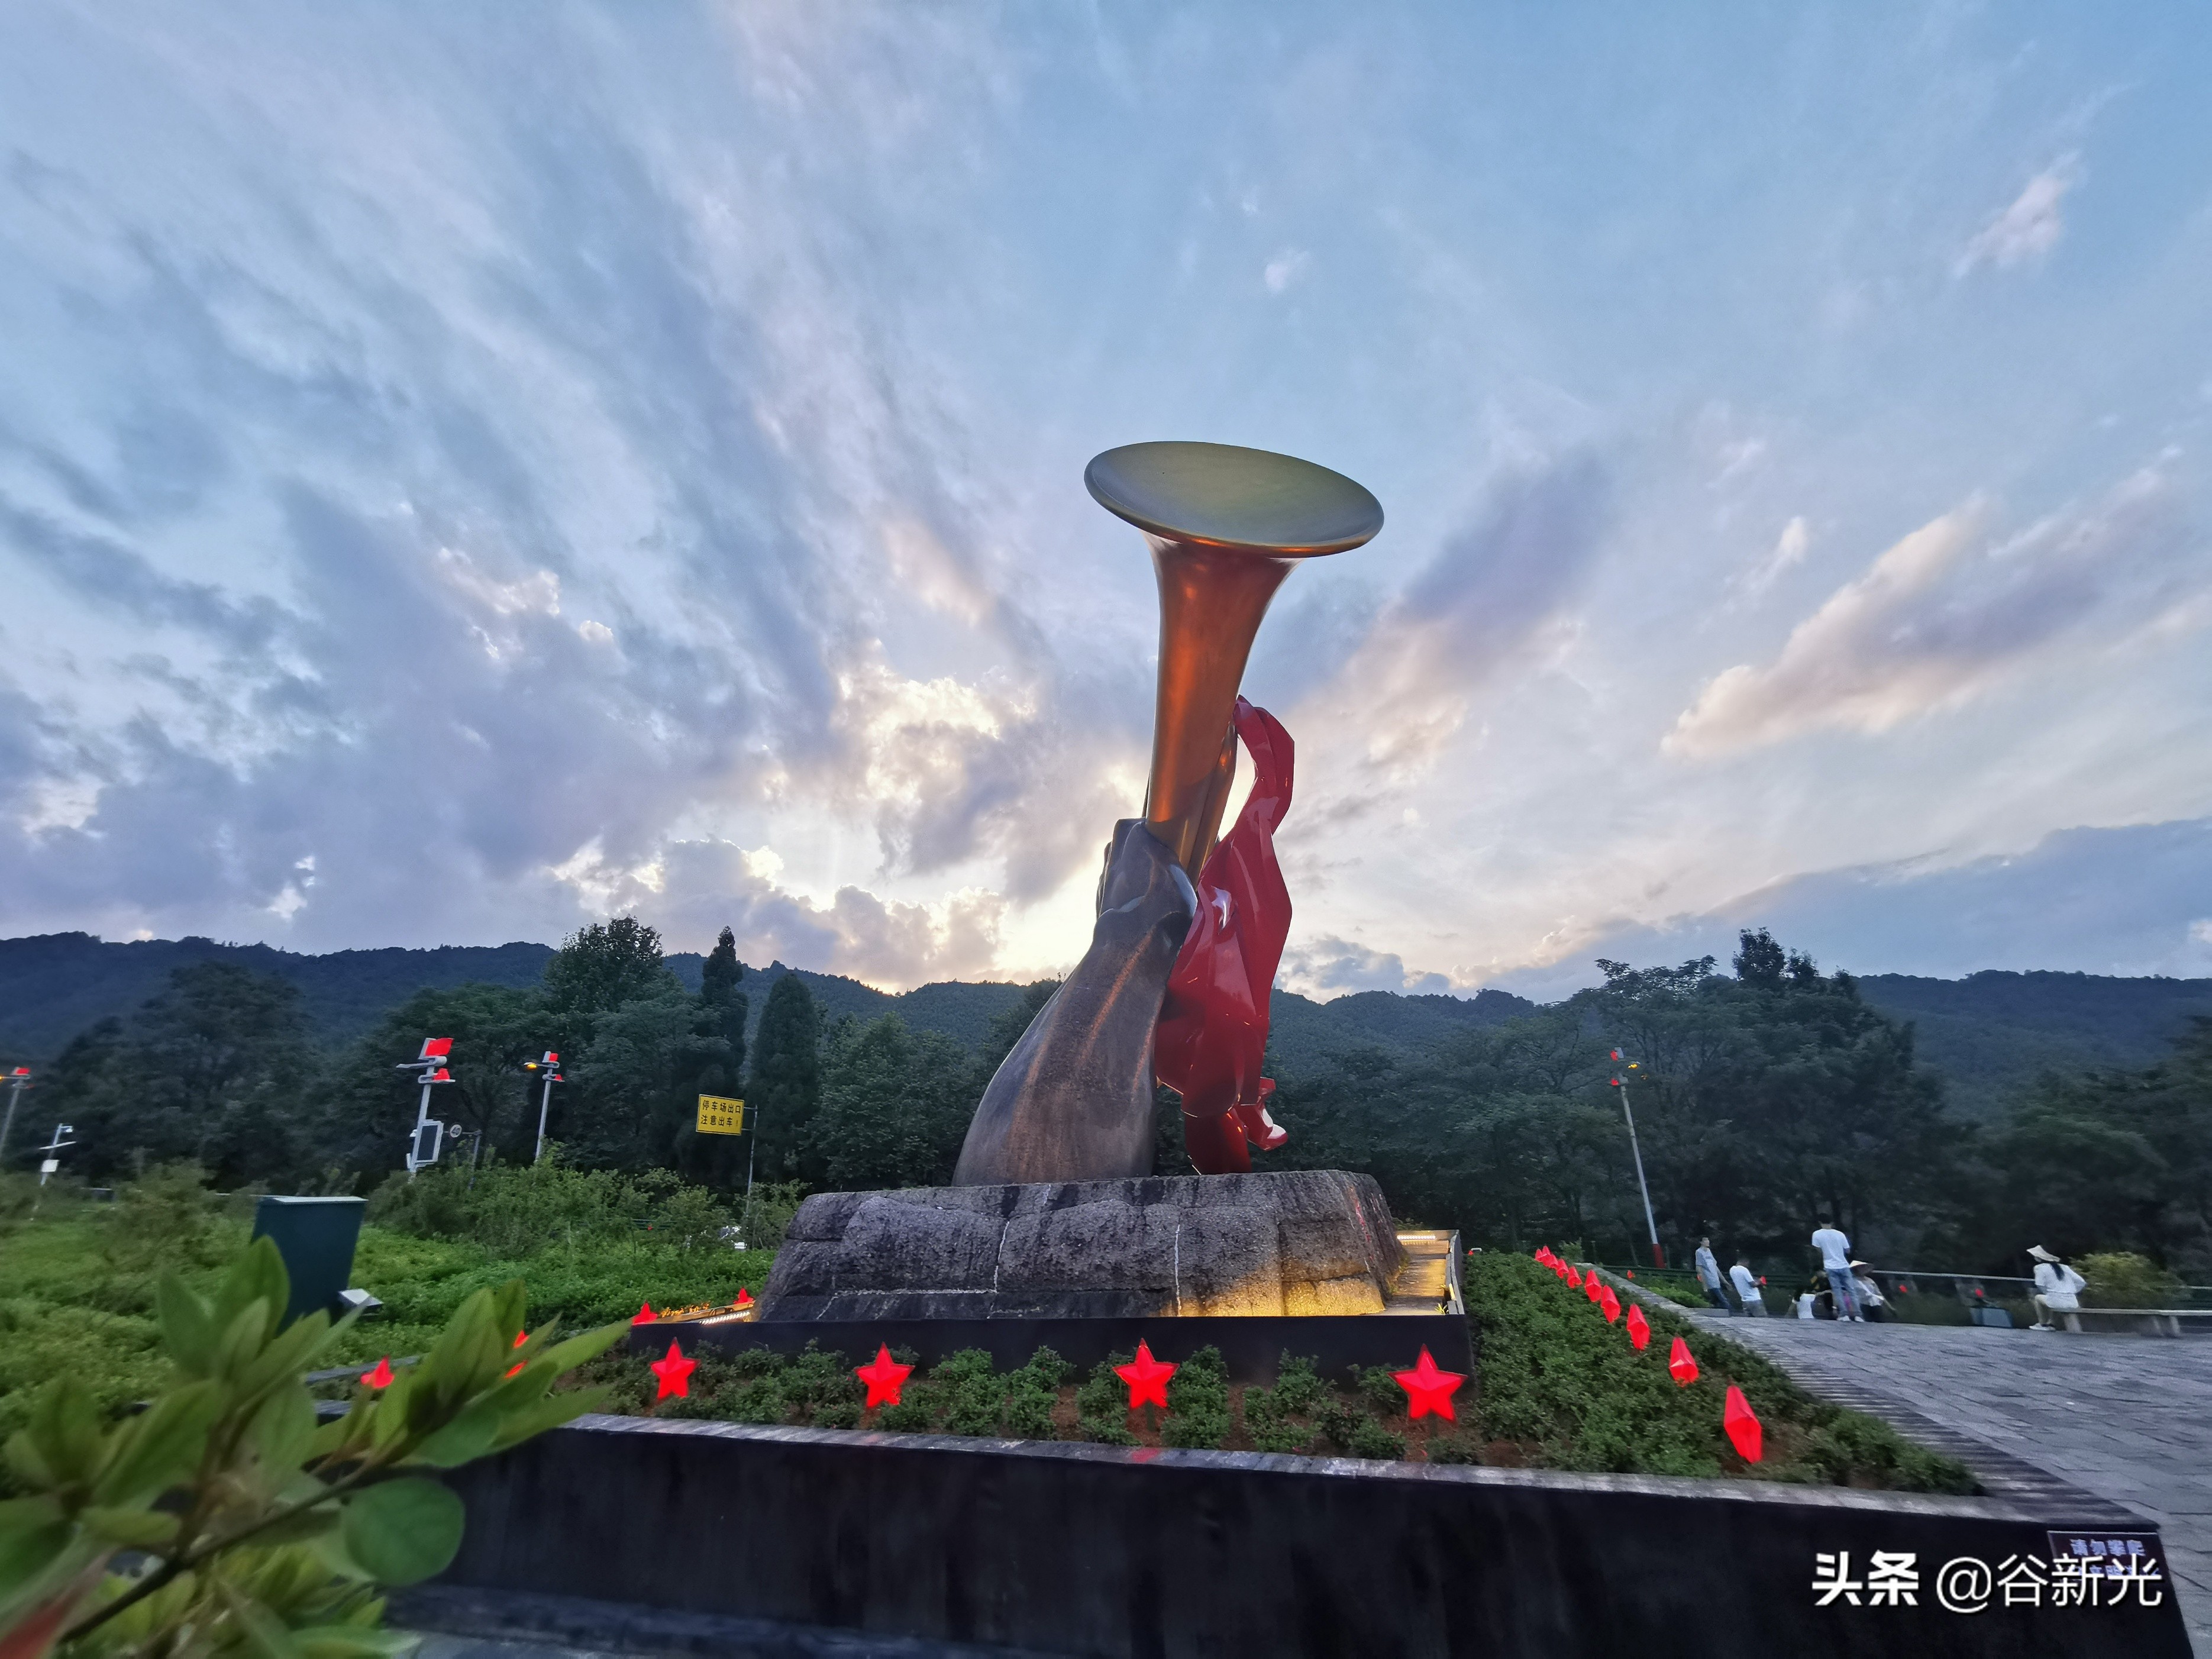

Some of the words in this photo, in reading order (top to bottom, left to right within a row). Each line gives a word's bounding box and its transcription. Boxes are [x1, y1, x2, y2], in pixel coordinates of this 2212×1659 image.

[703, 1100, 741, 1113] 停车场出口
[451, 1127, 460, 1135] 40
